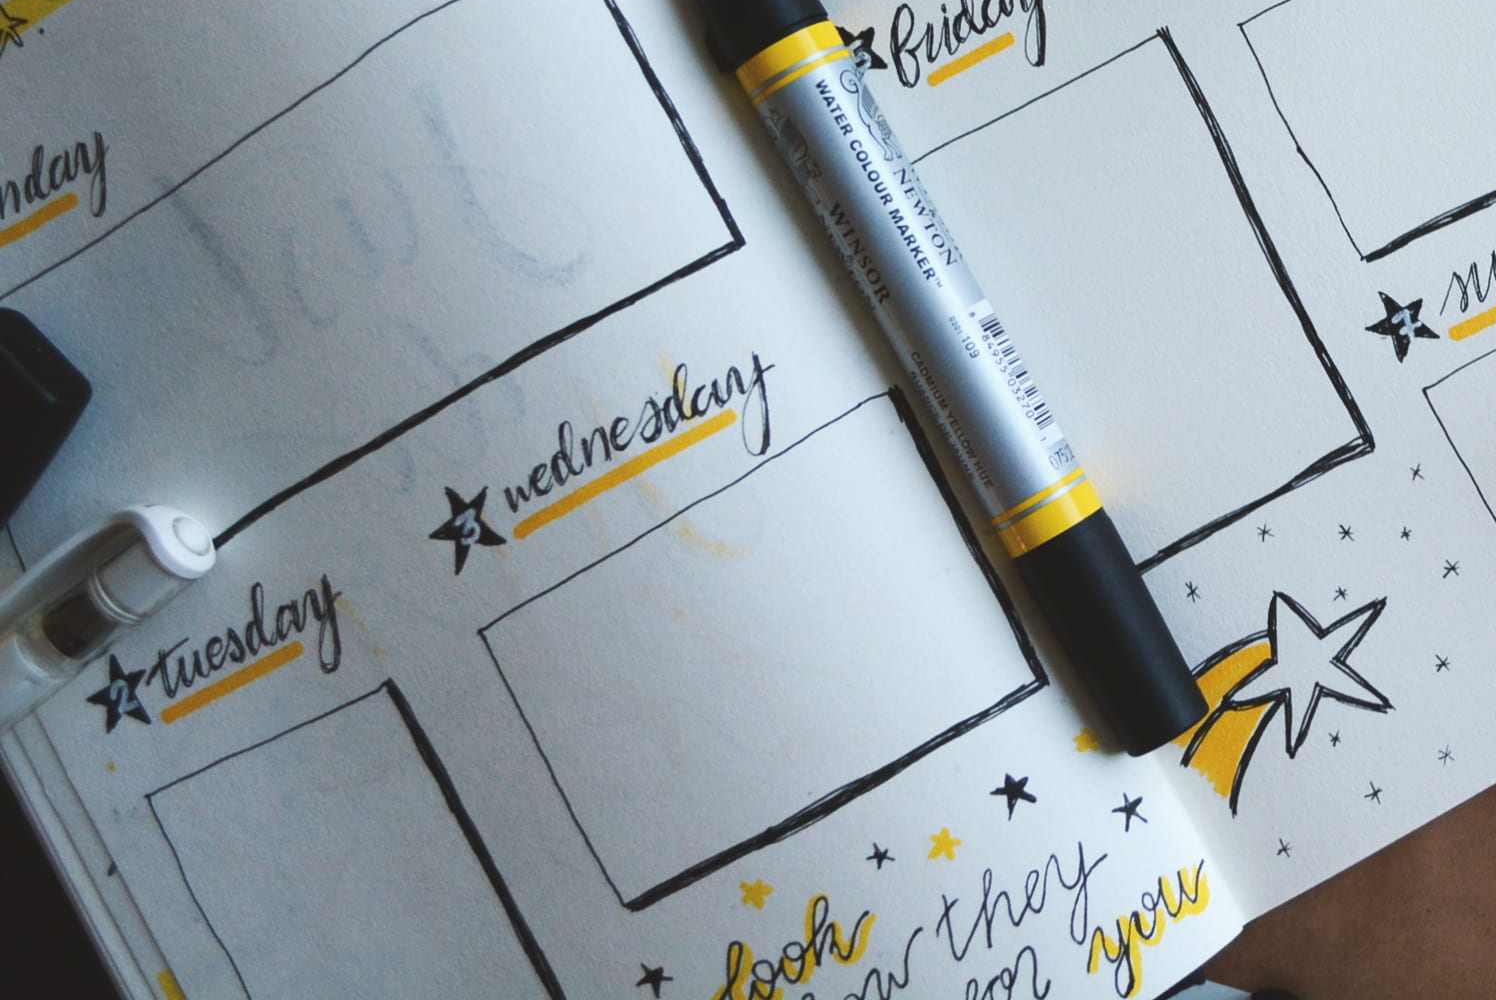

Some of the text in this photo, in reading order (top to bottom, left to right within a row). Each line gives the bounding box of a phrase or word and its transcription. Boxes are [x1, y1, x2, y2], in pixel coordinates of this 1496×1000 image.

[815, 79, 854, 137] WATER
[849, 139, 893, 206] COLOUR
[830, 202, 890, 304] WINSOR
[893, 168, 957, 266] NEWTON
[962, 335, 980, 359] 109
[453, 351, 775, 546] 3 wednesday
[912, 352, 994, 488] CADMIUM YELLOW HUE
[110, 574, 341, 715] 2 tuesday
[936, 842, 1107, 961] they
[1088, 858, 1205, 998] you
